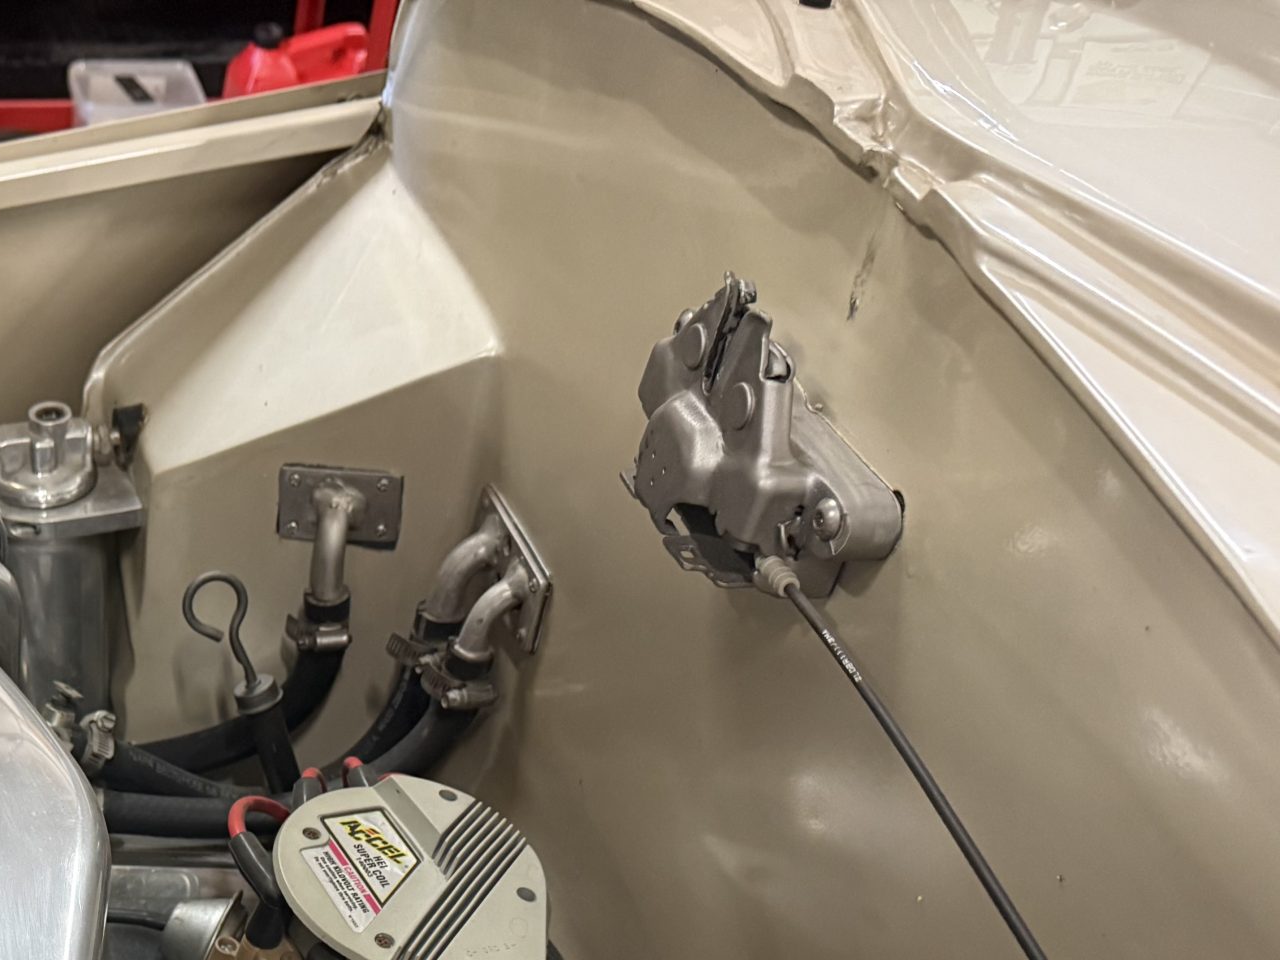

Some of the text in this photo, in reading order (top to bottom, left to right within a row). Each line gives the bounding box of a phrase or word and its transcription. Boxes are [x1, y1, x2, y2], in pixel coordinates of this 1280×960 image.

[339, 819, 407, 865] ACCEL
[373, 855, 388, 869] HEI
[343, 866, 366, 893] CAUTION
[353, 843, 390, 888] SUPER COIL
[333, 865, 355, 891] KILOVOLT
[351, 892, 369, 913] RATING
